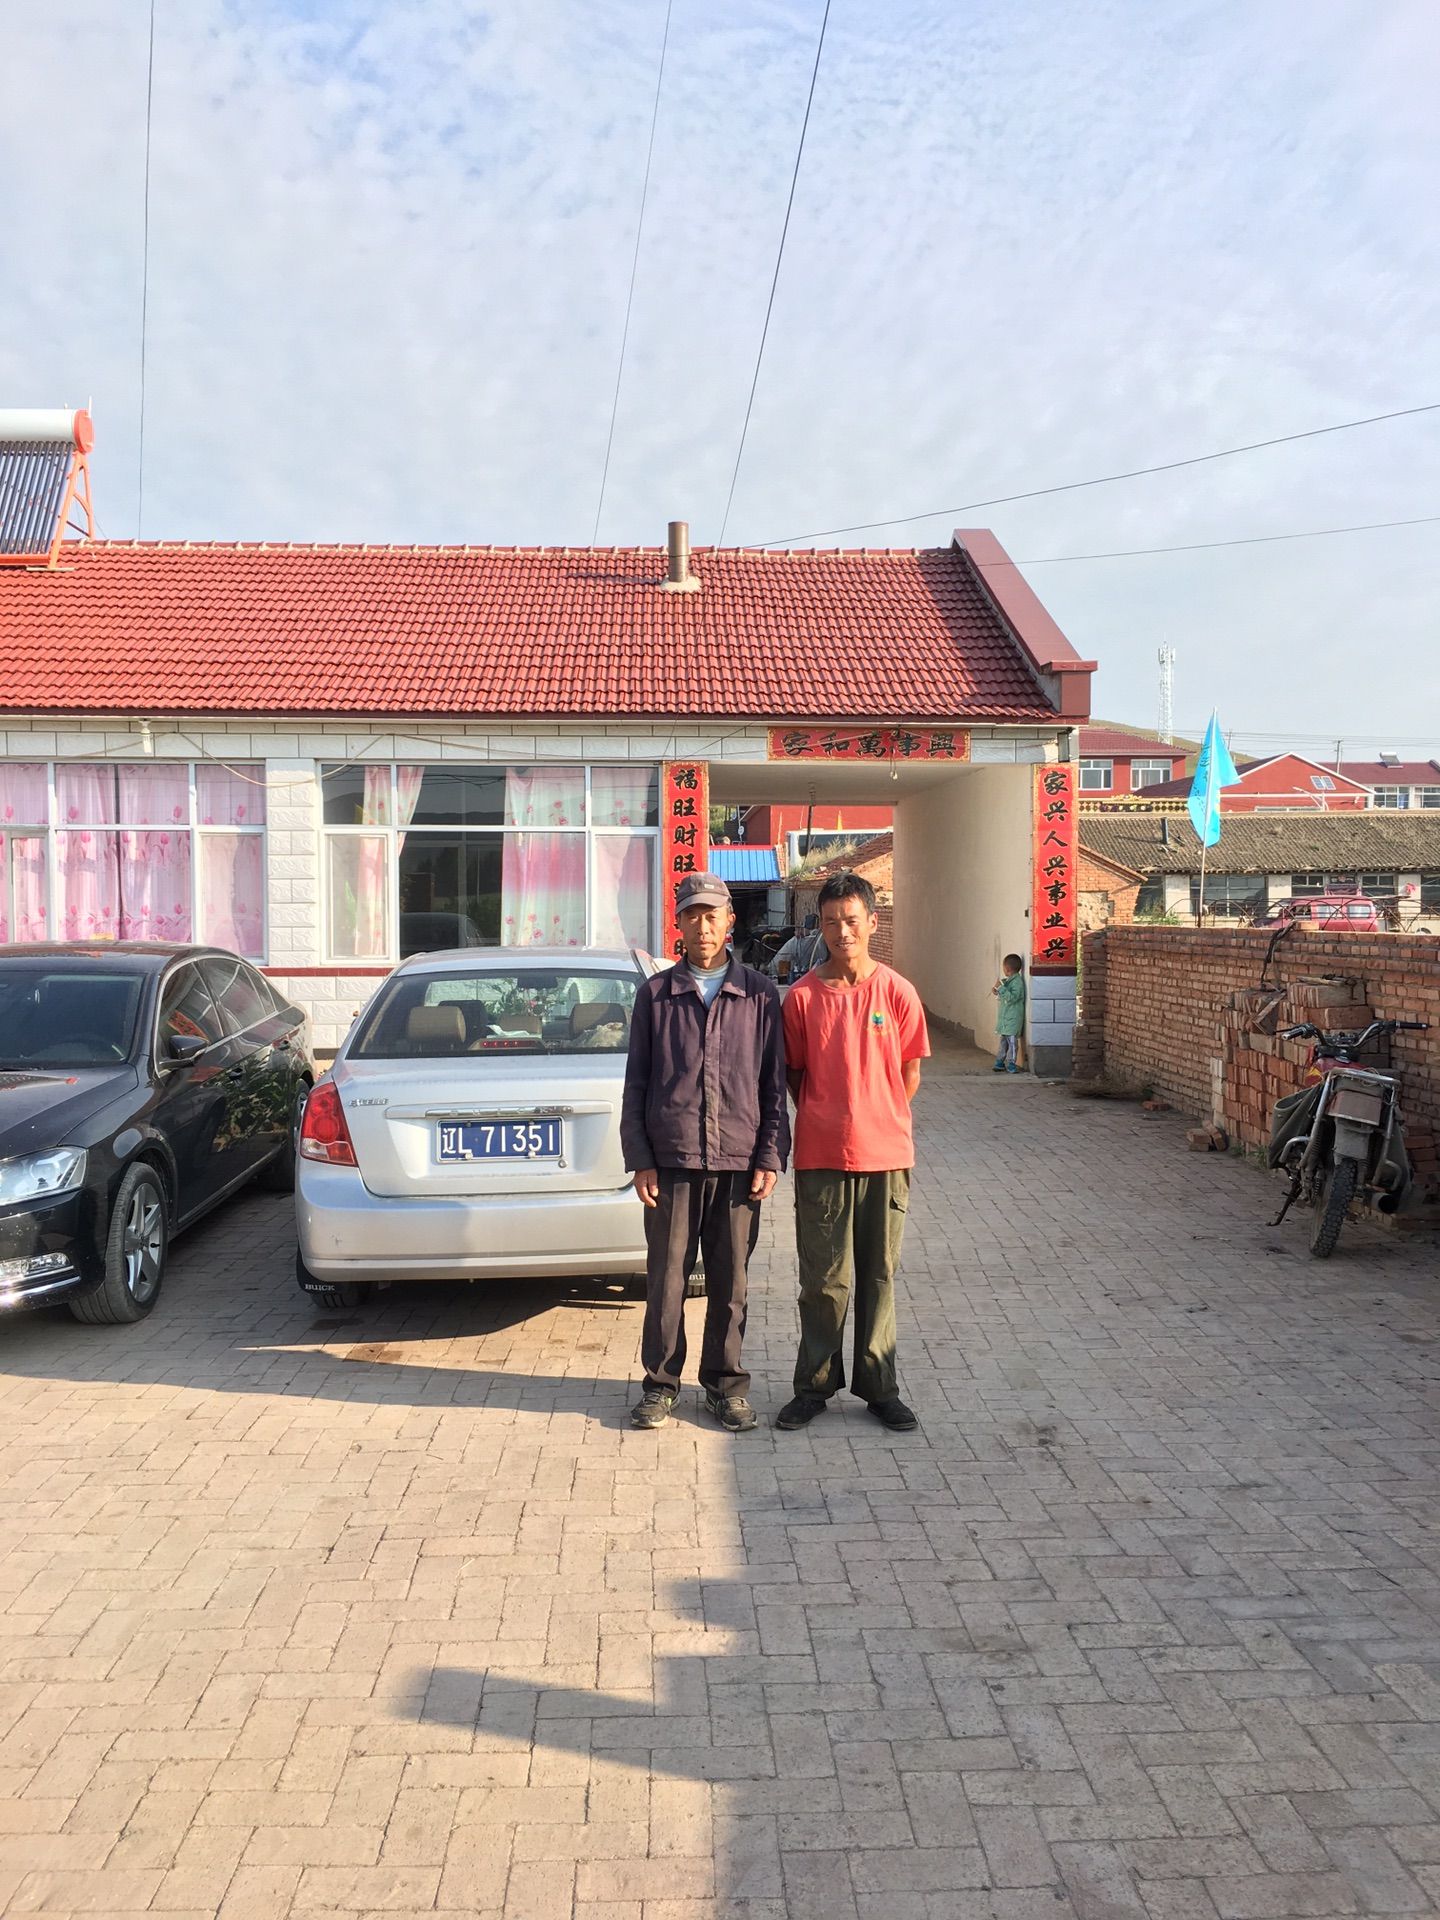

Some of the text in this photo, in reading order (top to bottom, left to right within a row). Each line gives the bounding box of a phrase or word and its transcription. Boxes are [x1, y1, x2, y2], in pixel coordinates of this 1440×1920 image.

[781, 731, 957, 757] 家和萬事興
[673, 769, 699, 957] 福旺财旺
[1042, 770, 1068, 958] 家兴人兴事业兴
[304, 1283, 336, 1292] BUICK
